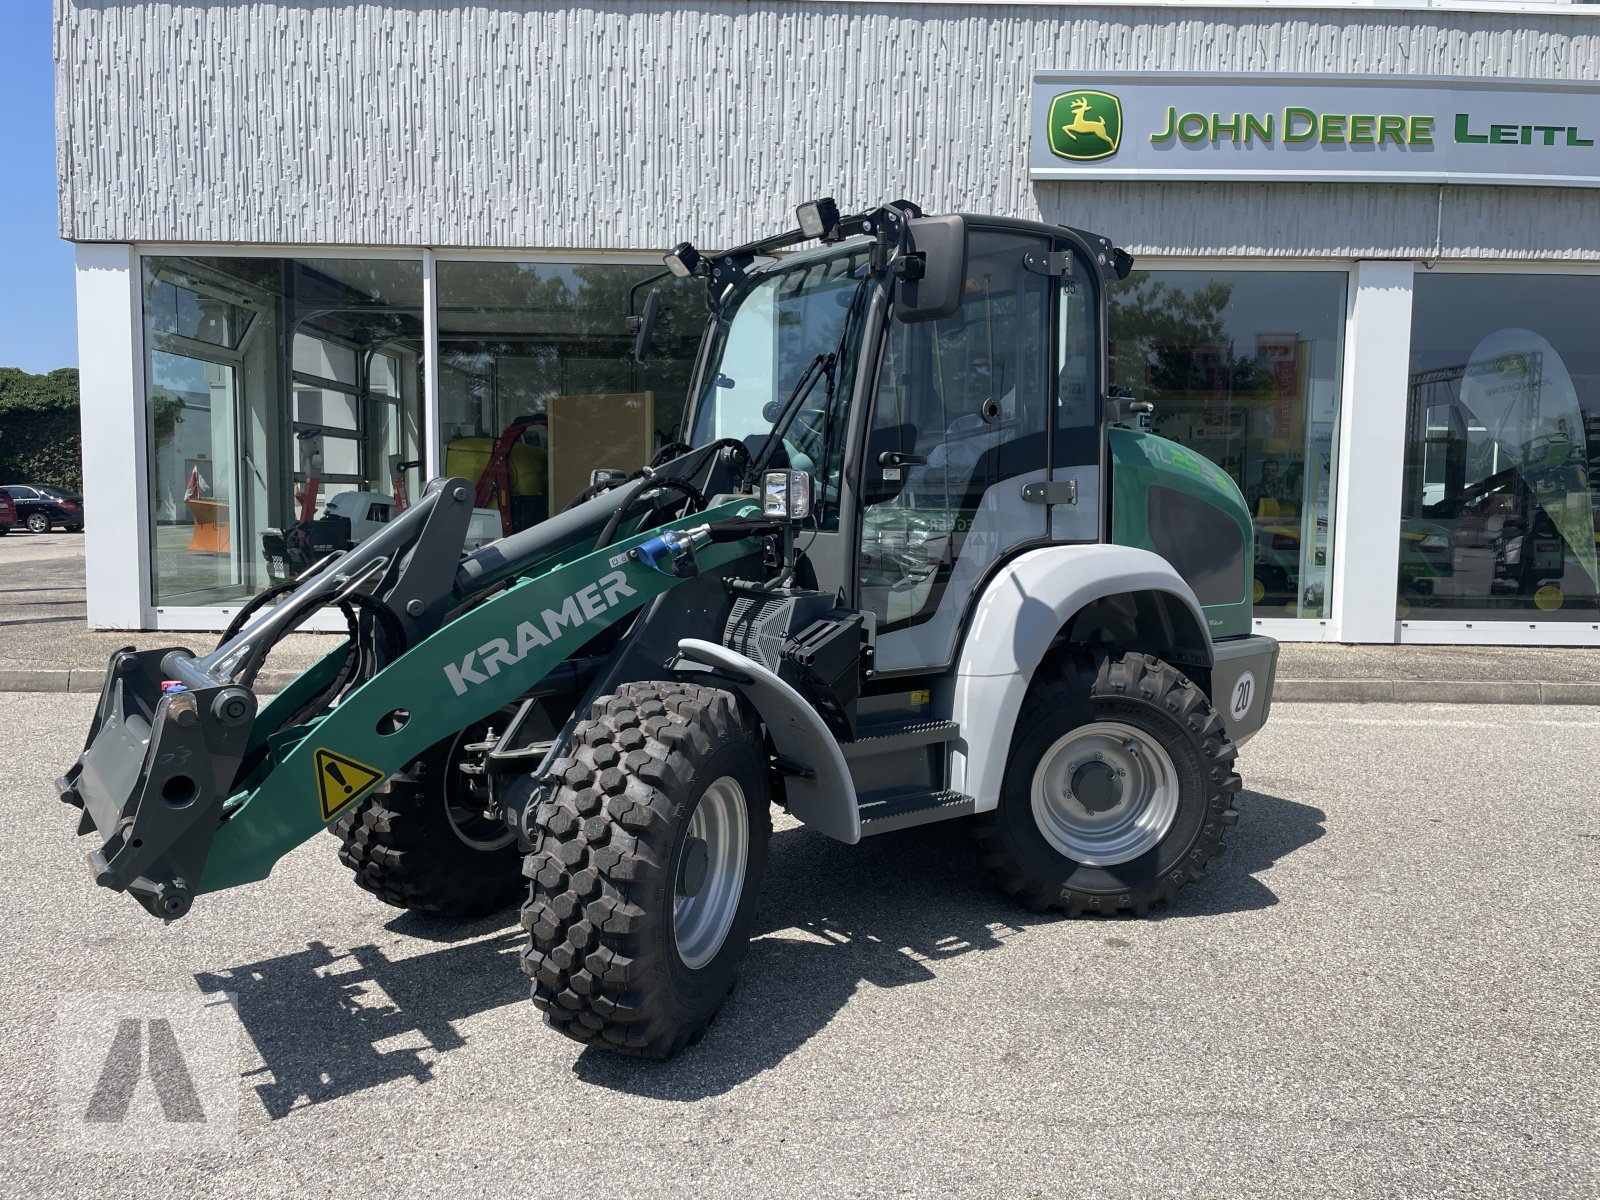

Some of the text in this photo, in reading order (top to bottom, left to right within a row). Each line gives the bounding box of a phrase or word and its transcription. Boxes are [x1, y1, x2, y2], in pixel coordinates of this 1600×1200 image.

[1150, 106, 1594, 146] JOHN DEERE LEITL
[1064, 280, 1076, 294] 85
[443, 570, 638, 697] KRAMER
[1235, 680, 1250, 713] 20
